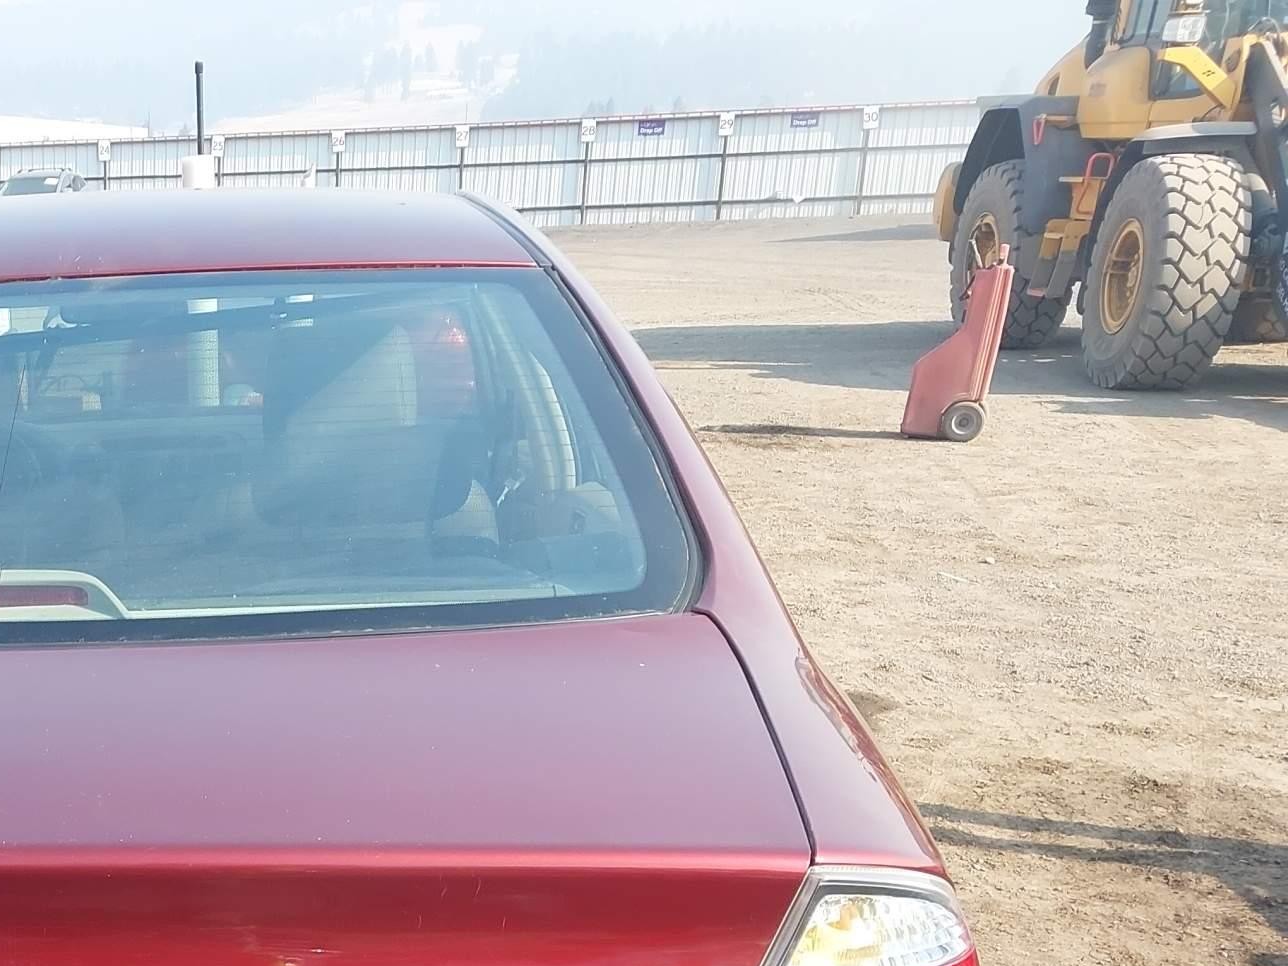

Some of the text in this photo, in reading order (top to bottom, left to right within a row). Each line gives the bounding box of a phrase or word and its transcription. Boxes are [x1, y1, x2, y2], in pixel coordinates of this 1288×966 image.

[864, 111, 879, 122] 30
[720, 119, 734, 129] 29
[456, 131, 469, 141] 27
[582, 126, 596, 136] 28
[332, 135, 345, 146] 26
[99, 145, 110, 155] 24
[213, 141, 224, 151] 25
